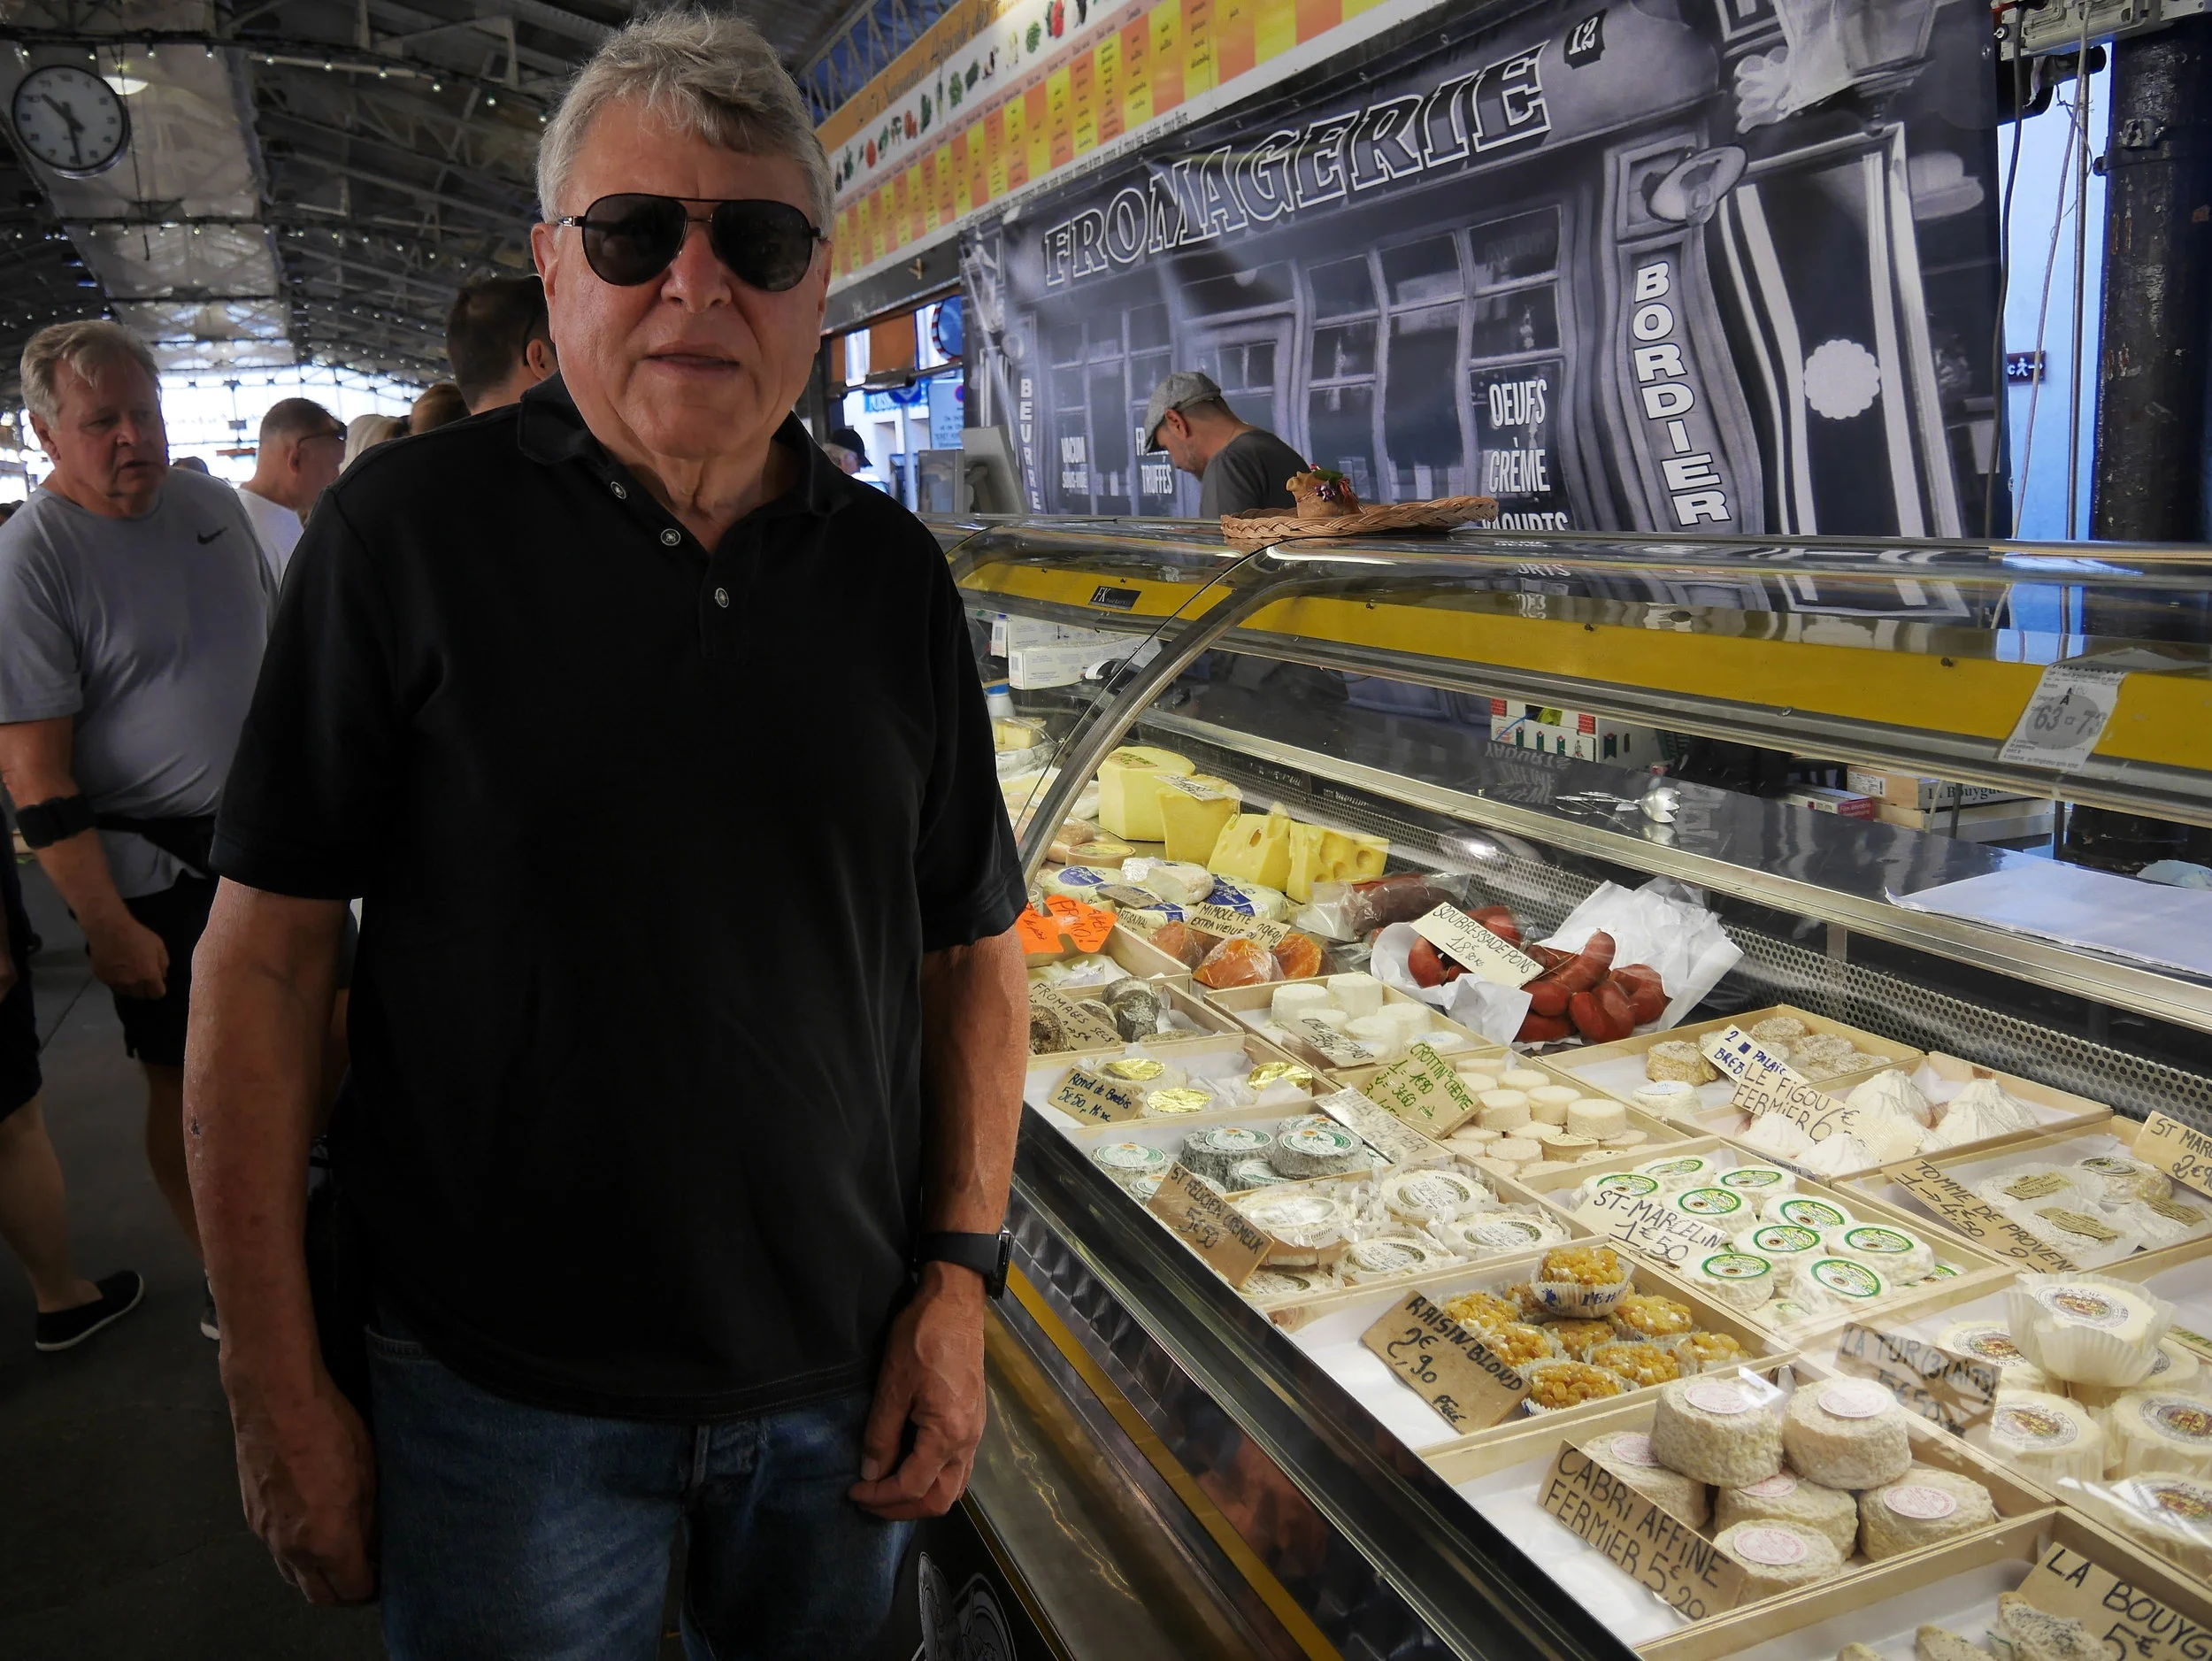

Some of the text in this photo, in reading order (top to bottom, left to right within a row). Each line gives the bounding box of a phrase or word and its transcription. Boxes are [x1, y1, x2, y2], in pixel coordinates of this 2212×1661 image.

[1569, 18, 1596, 54] 12
[1046, 40, 1552, 287] FROMAGERIE
[1488, 379, 1548, 427] OEUFS
[1632, 261, 1731, 527] BORDIER
[1019, 378, 1041, 511] BEURRE
[1488, 437, 1551, 493] CRÈME
[1432, 904, 1536, 974] SOUBRESSADE PONS
[1033, 982, 1115, 1043] FROMAGES SECS
[1724, 1030, 1740, 1043] 2
[1409, 1042, 1448, 1081] CROTTIN
[1714, 1047, 1746, 1078] BREB
[1742, 1060, 1771, 1087] LE
[1068, 1073, 1097, 1091] Rond
[1094, 1084, 1105, 1096] de
[2150, 1117, 2178, 1139] ST
[1171, 1166, 1189, 1186] ST
[1915, 1159, 1977, 1204] TOMME
[1972, 1204, 2006, 1223] DE
[1998, 1223, 2080, 1274] PROVEN
[1405, 1296, 1524, 1391] RAISIN-BLOND
[2045, 1548, 2093, 1589] LA
